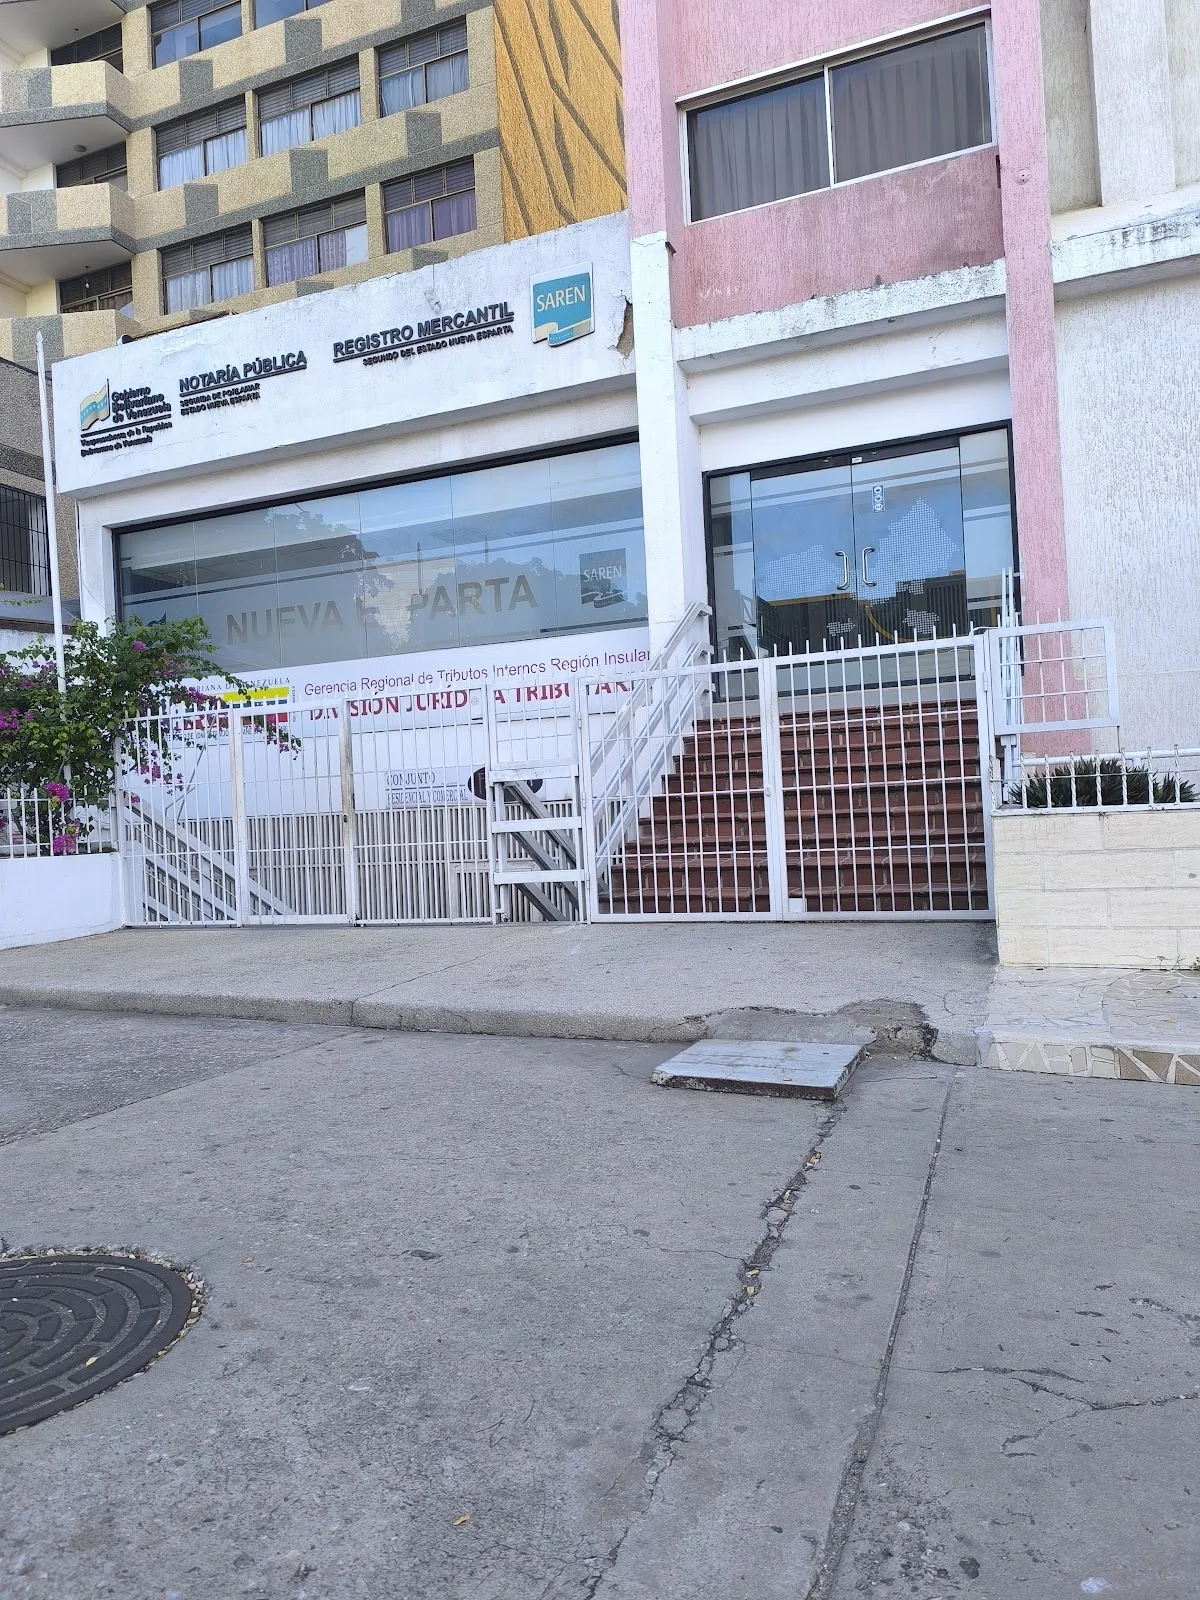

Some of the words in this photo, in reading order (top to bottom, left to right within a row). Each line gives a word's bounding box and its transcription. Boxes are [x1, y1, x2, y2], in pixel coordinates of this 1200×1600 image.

[536, 284, 586, 313] SAREN
[334, 325, 413, 356] REGISTRO
[417, 302, 514, 337] MERCANTIL
[363, 352, 399, 366] SEGUNDO
[400, 346, 415, 358] DEL
[417, 340, 448, 354] ESTADO
[449, 333, 476, 346] NUEVA
[477, 324, 514, 341] ESPARTA
[179, 364, 241, 392] NOTARÍA
[243, 350, 307, 377] PÚBLICA
[111, 386, 151, 402] Gobierno
[112, 393, 165, 413] Bolivariano
[180, 394, 211, 407] SEGUNDA
[212, 391, 222, 400] DE
[222, 382, 260, 397] PORLAMAR
[181, 404, 206, 416] ESTADO
[207, 398, 229, 410] NUEVA
[230, 391, 260, 405] ESPARTA
[112, 412, 124, 423] de
[125, 401, 172, 420] Venezuela
[583, 564, 622, 583] SAREN
[226, 600, 344, 645] NUEVA
[304, 679, 357, 696] Gerencia
[361, 673, 414, 692] Regional
[418, 671, 433, 684] de
[437, 667, 488, 683] Tributos
[551, 654, 599, 672] Región
[604, 648, 650, 665] Insular
